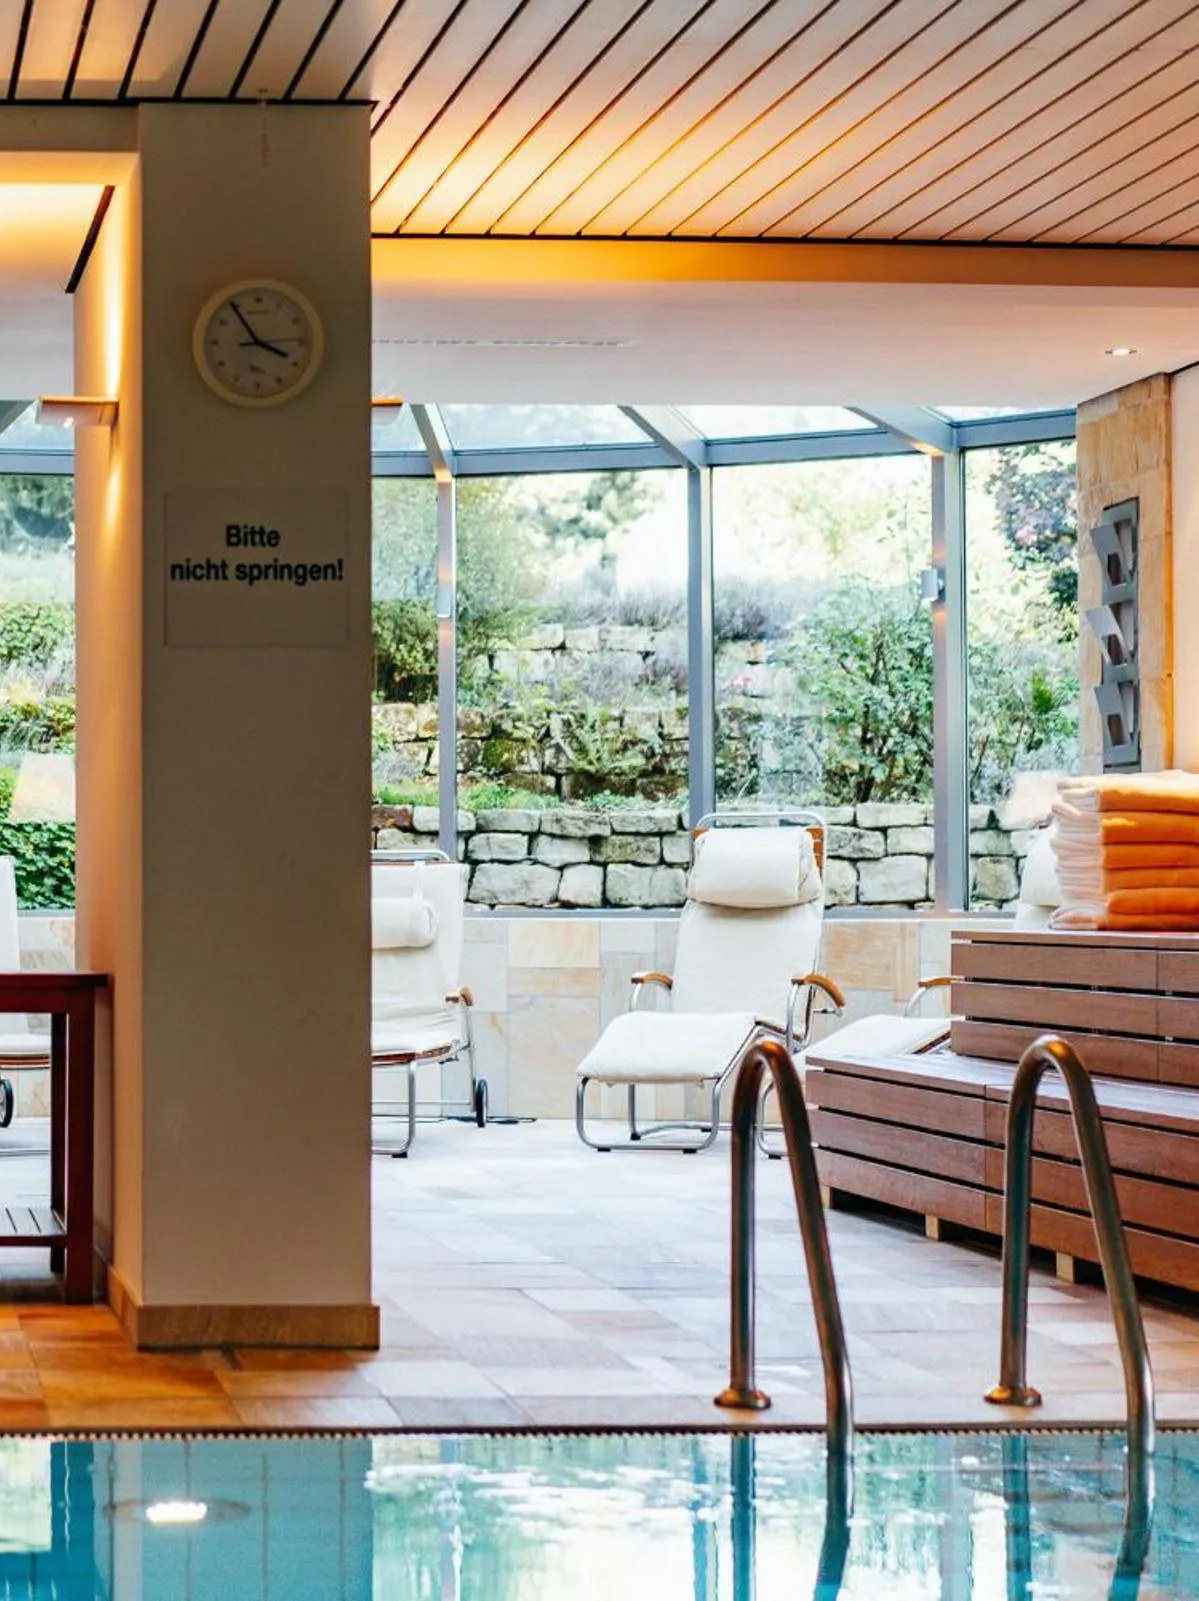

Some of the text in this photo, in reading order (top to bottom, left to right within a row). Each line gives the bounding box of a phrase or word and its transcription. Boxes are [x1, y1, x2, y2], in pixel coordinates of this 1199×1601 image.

[225, 523, 280, 548] Bitte
[169, 557, 344, 587] nicht springen!
